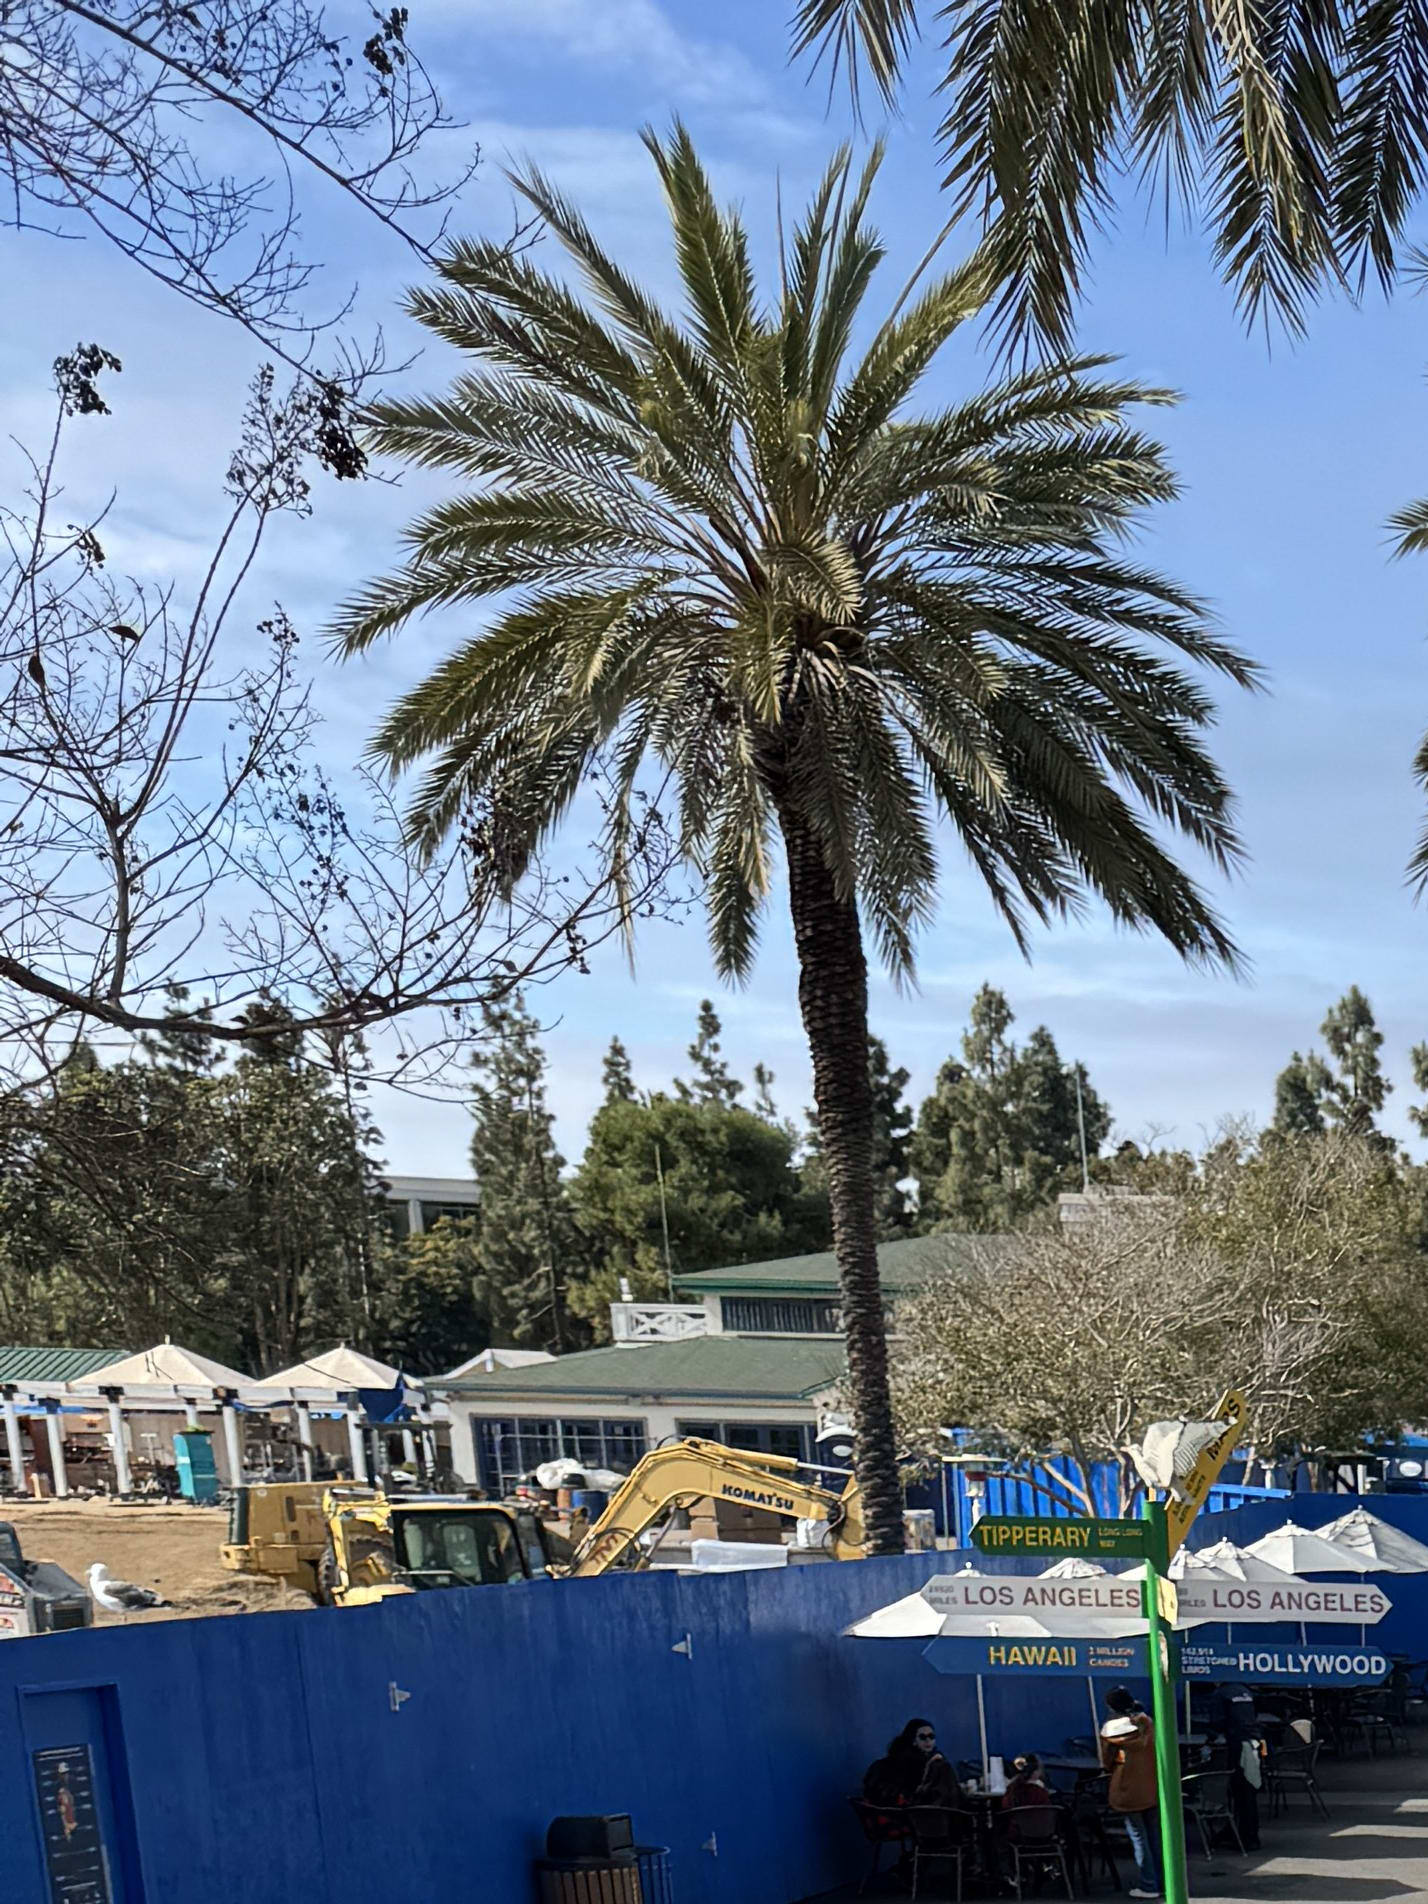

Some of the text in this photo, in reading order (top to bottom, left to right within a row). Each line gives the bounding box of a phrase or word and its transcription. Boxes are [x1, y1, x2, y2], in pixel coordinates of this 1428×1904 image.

[722, 1483, 794, 1511] KOMATSU
[979, 1525, 1091, 1548] TIPPERARY
[964, 1586, 1141, 1608] LOS ANGELES
[1213, 1589, 1384, 1613] LOS ANGELES
[988, 1646, 1077, 1667] HAWAII
[1238, 1652, 1386, 1675] HOLLYWOOD
